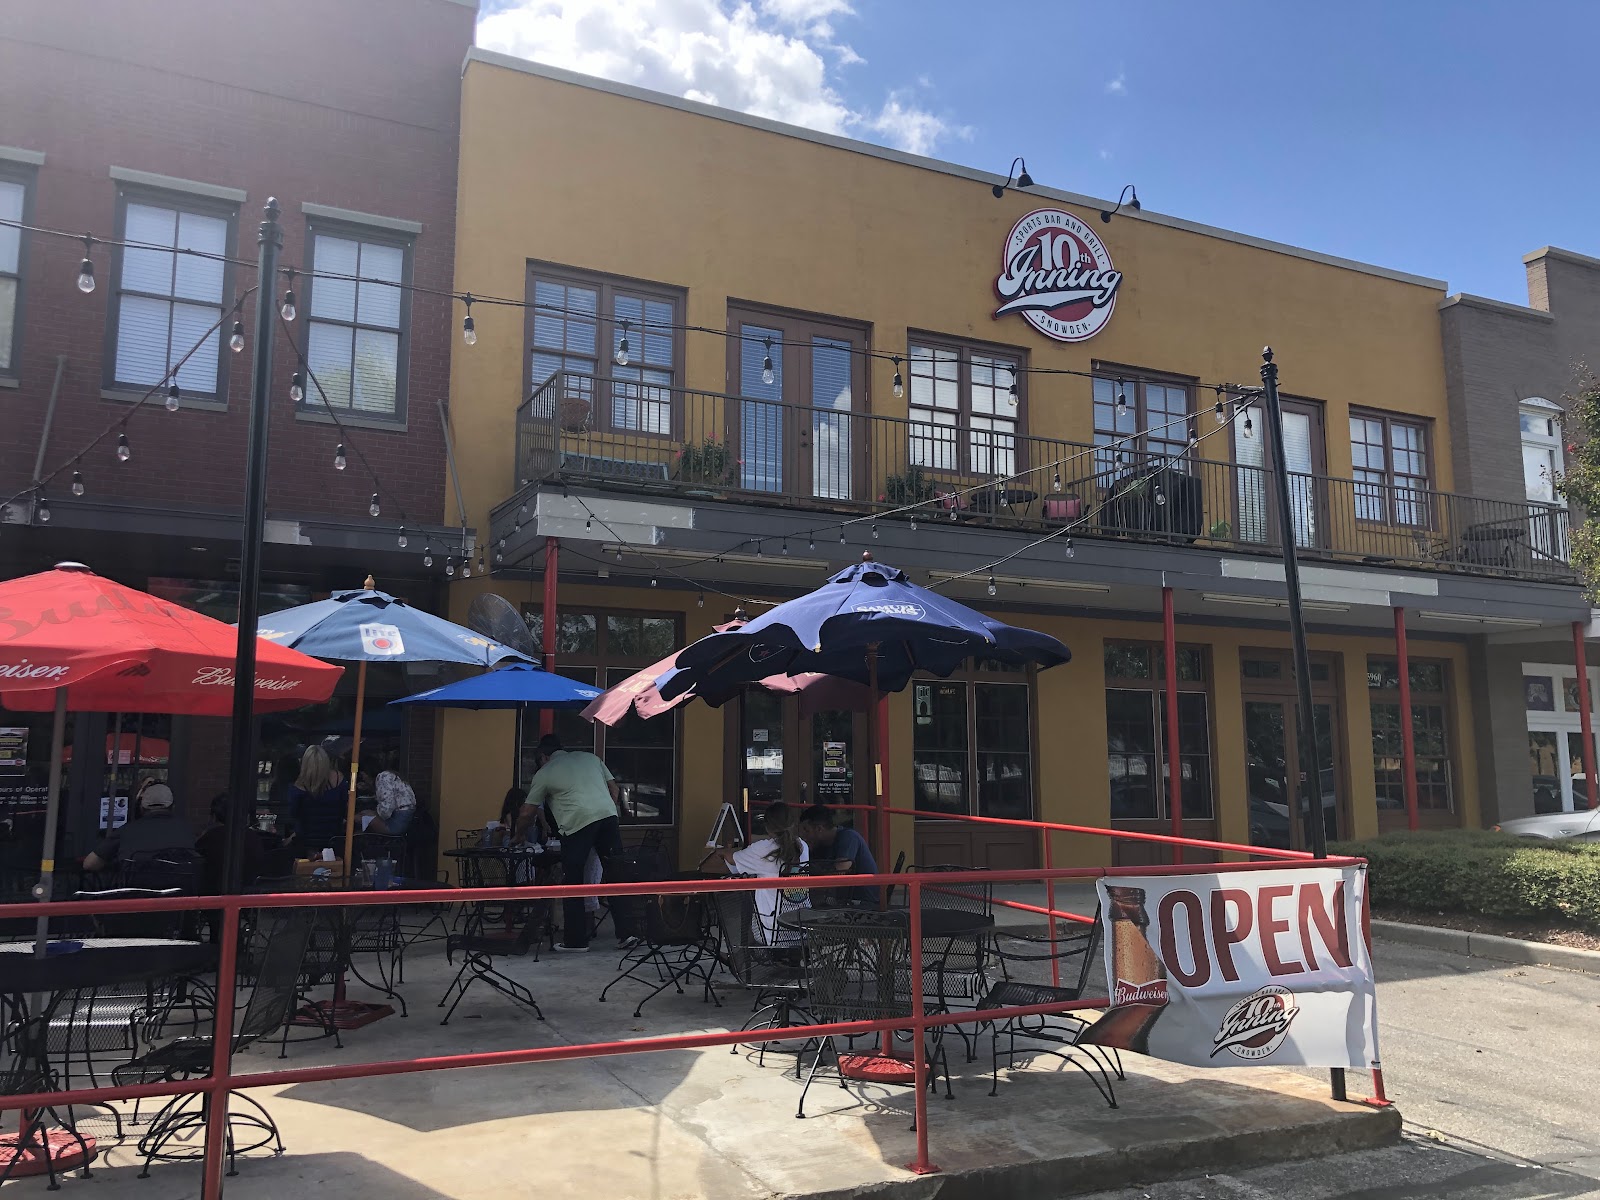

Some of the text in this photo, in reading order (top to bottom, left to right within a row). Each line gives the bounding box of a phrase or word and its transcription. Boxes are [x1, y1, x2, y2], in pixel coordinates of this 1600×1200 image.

[1016, 215, 1102, 260] SPORTS BAR AND GRILL
[1037, 231, 1091, 271] 10th
[997, 244, 1122, 307] Inning
[1040, 315, 1089, 335] SNOWDEN
[1157, 880, 1354, 987] OPEN
[1115, 986, 1168, 1005] Budweiser
[1214, 1006, 1300, 1044] Inning
